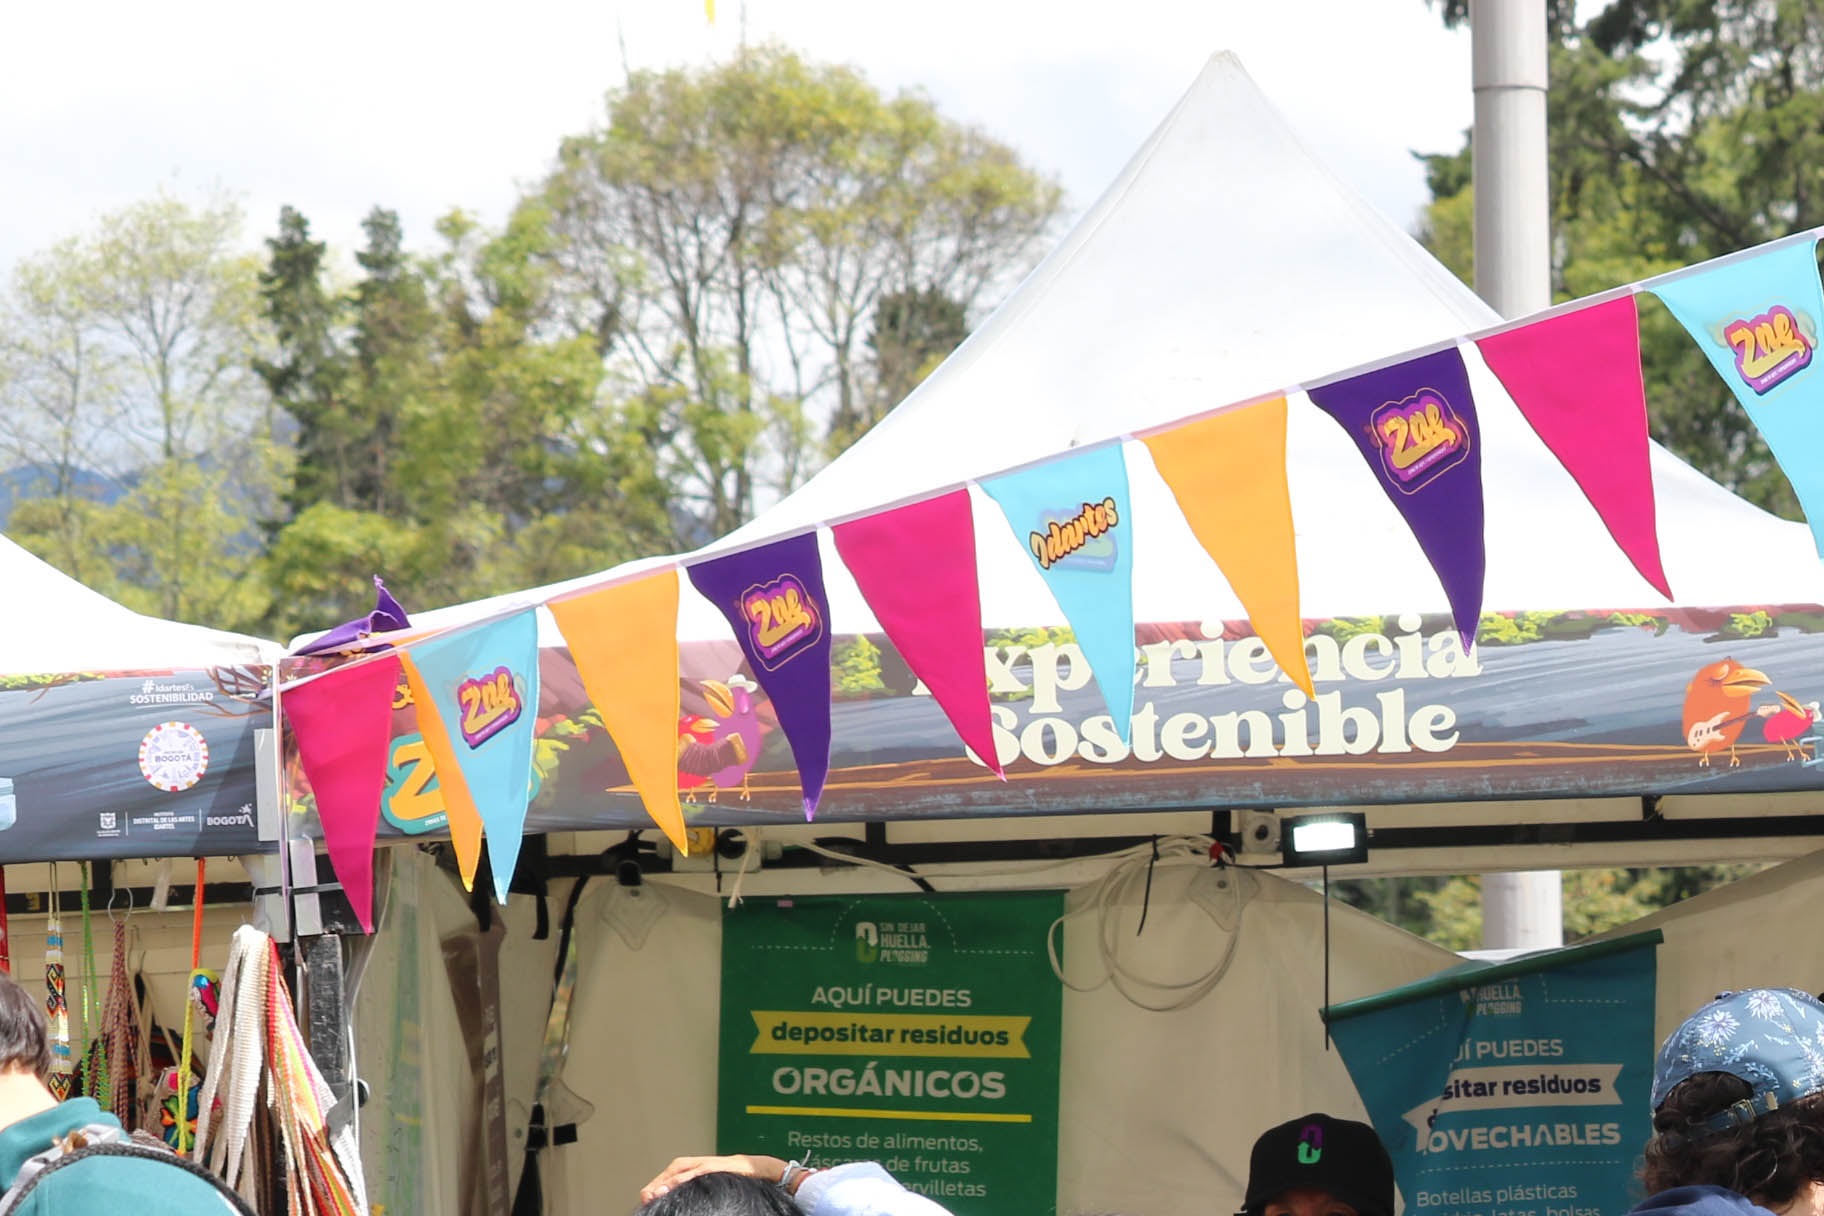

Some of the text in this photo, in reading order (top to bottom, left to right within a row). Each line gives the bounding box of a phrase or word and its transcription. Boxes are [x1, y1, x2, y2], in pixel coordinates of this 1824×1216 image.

[129, 692, 214, 704] SOSTENIBILIDAD
[811, 984, 972, 1008] AQUÍ PUEDES
[771, 1021, 1009, 1046] depositar residuos
[1476, 1039, 1564, 1060] PUEDES
[772, 1061, 1006, 1099] ORGÁNICOS
[1503, 1074, 1602, 1096] residuos
[788, 1131, 984, 1153] Restos de alimentos,
[1428, 1122, 1621, 1153] OVECHABLES
[886, 1156, 910, 1172] de
[915, 1156, 971, 1174] frutas
[903, 1180, 987, 1197] ervilletas
[1416, 1183, 1577, 1208] Botellas plásticas
